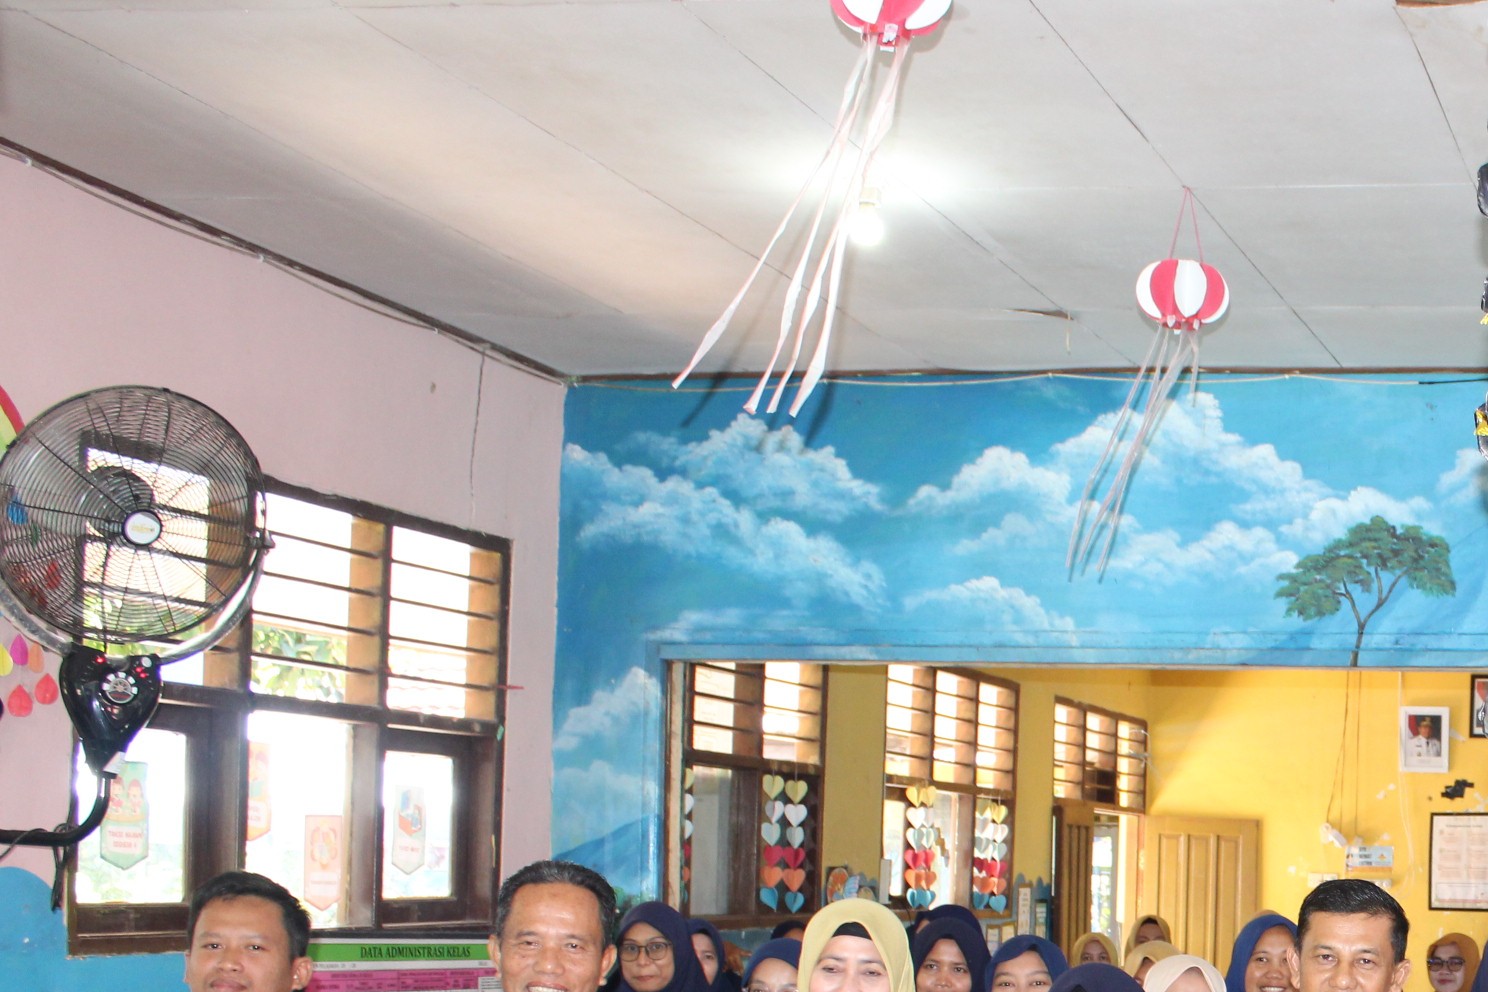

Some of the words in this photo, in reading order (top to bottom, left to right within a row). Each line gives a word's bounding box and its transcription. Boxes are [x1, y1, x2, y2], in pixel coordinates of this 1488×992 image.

[360, 946, 383, 959] DATA
[385, 946, 445, 959] ADMINISTRASI
[447, 946, 472, 958] KELAS
